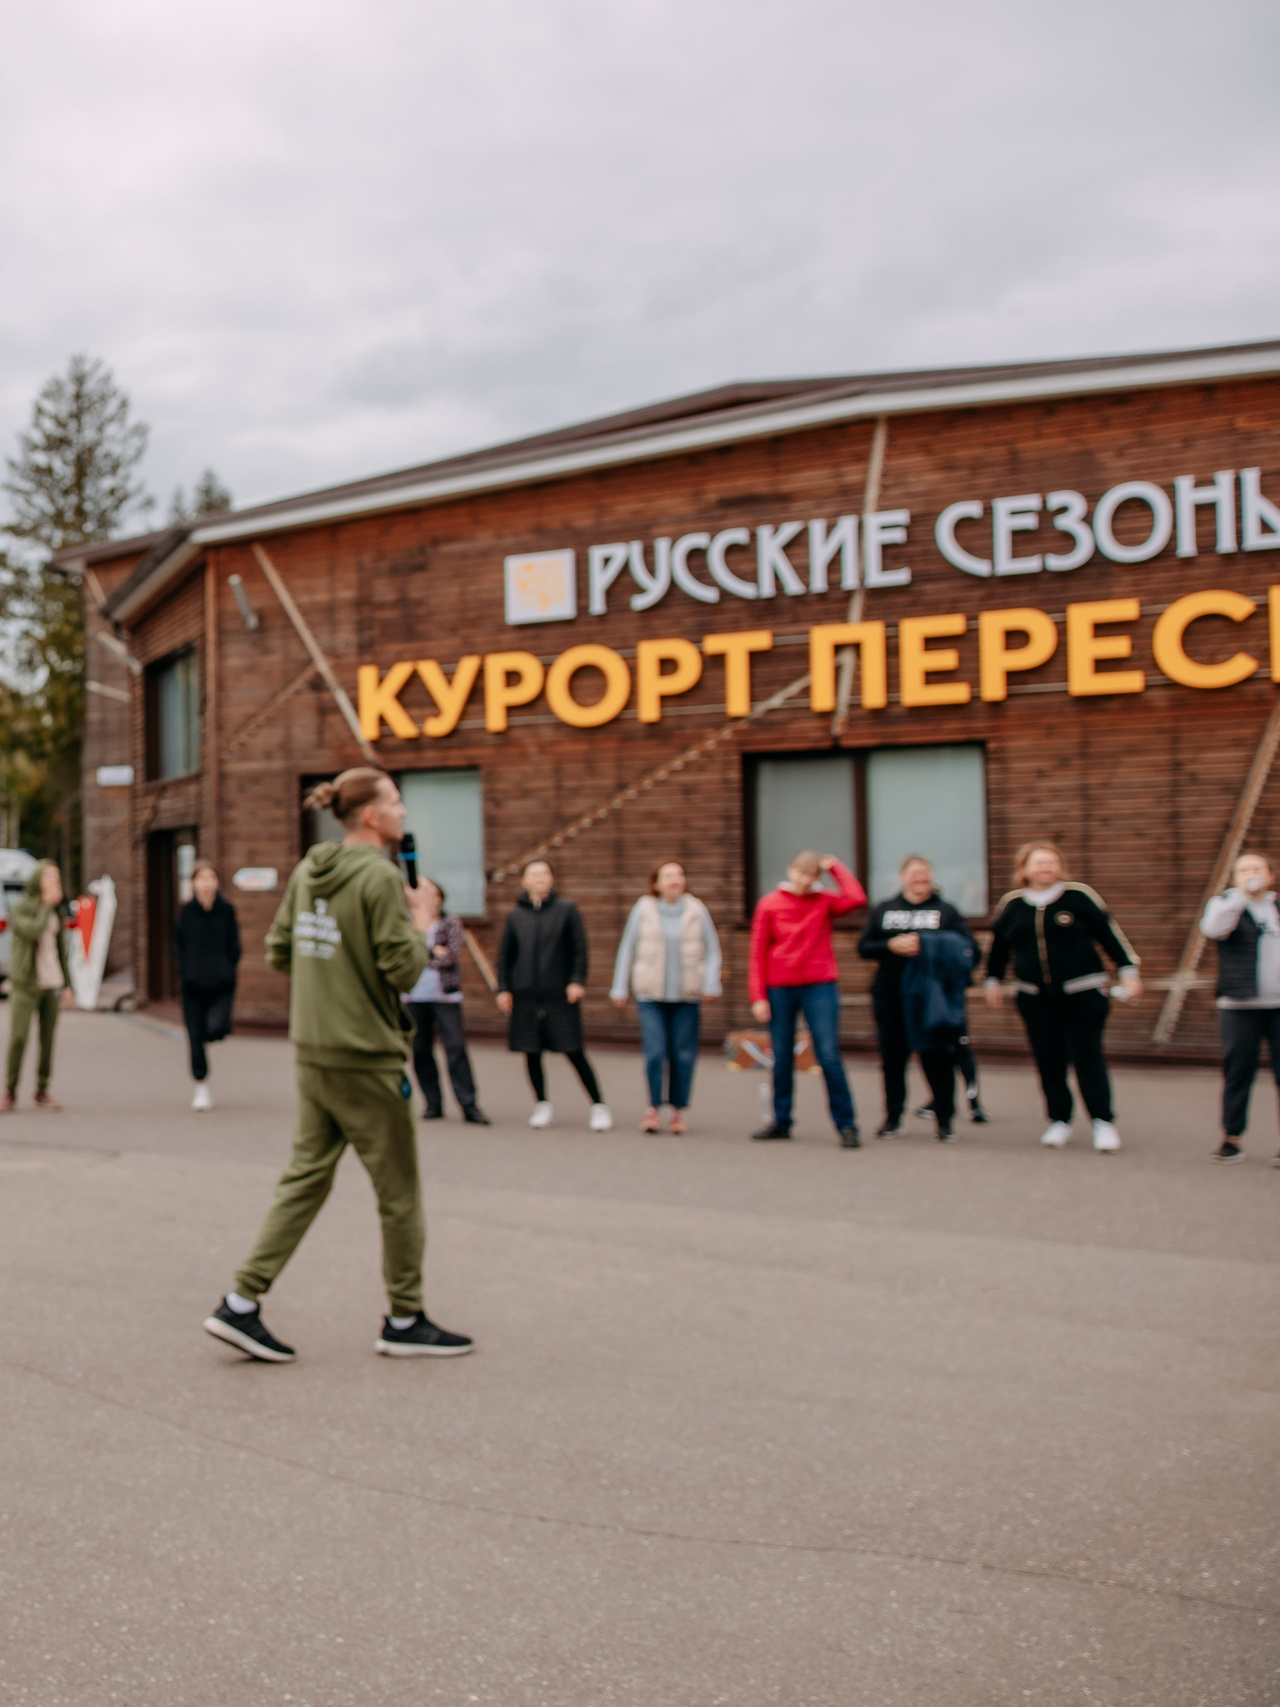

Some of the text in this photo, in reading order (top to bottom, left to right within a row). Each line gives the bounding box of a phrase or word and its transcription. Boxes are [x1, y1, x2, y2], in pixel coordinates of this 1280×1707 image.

[588, 508, 913, 615] РУССКИЕ
[357, 585, 1280, 741] КУРОРТ ПЕРЕС
